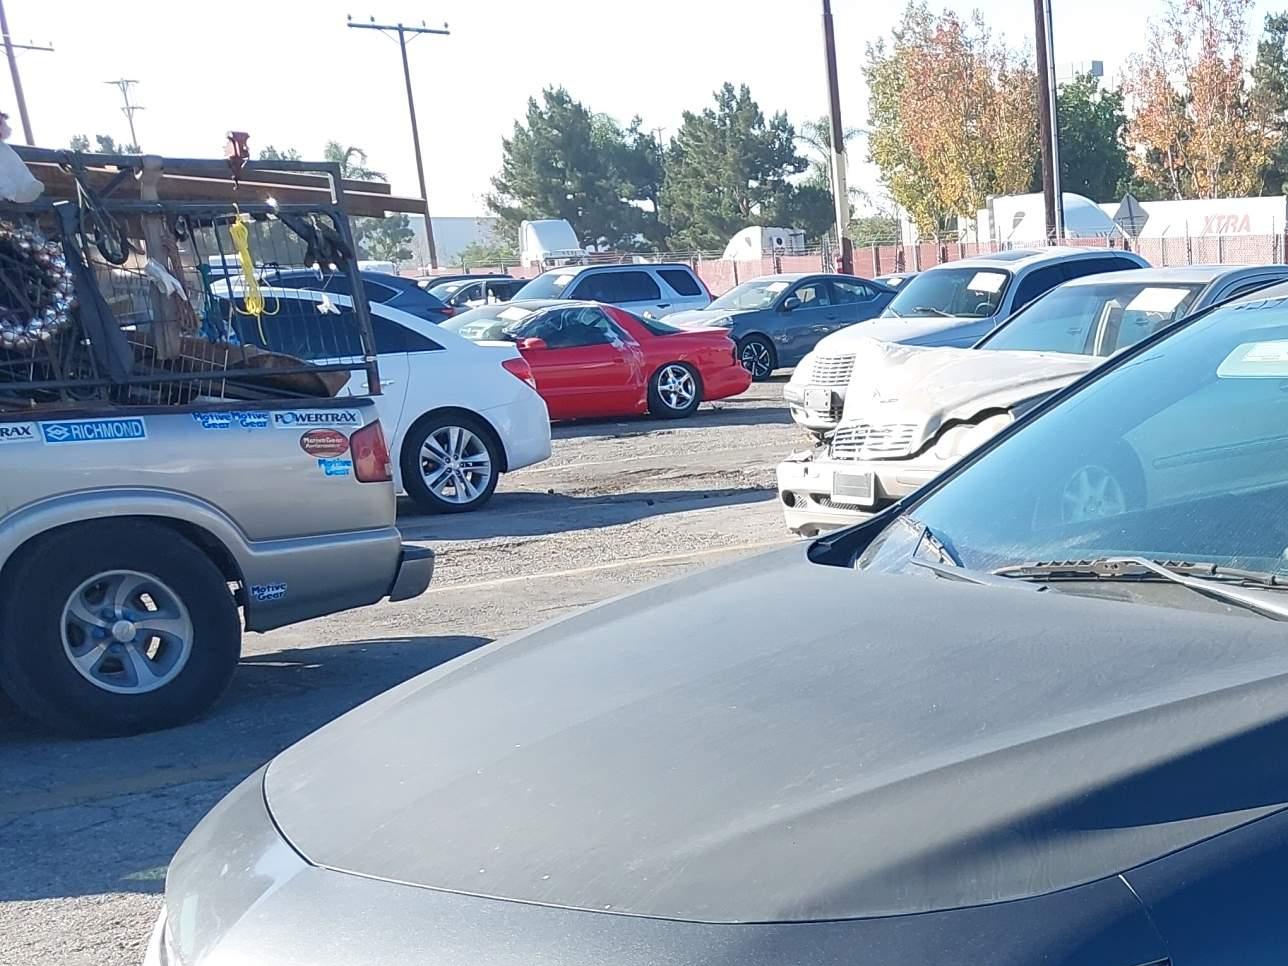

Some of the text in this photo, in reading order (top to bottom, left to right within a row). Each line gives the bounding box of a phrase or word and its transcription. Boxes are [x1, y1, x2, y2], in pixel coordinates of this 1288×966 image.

[1201, 213, 1251, 233] XTRA
[274, 411, 356, 424] POWERTRAX
[70, 421, 141, 440] RICHMOND
[251, 583, 287, 595] Motive
[257, 591, 285, 601] Gear
